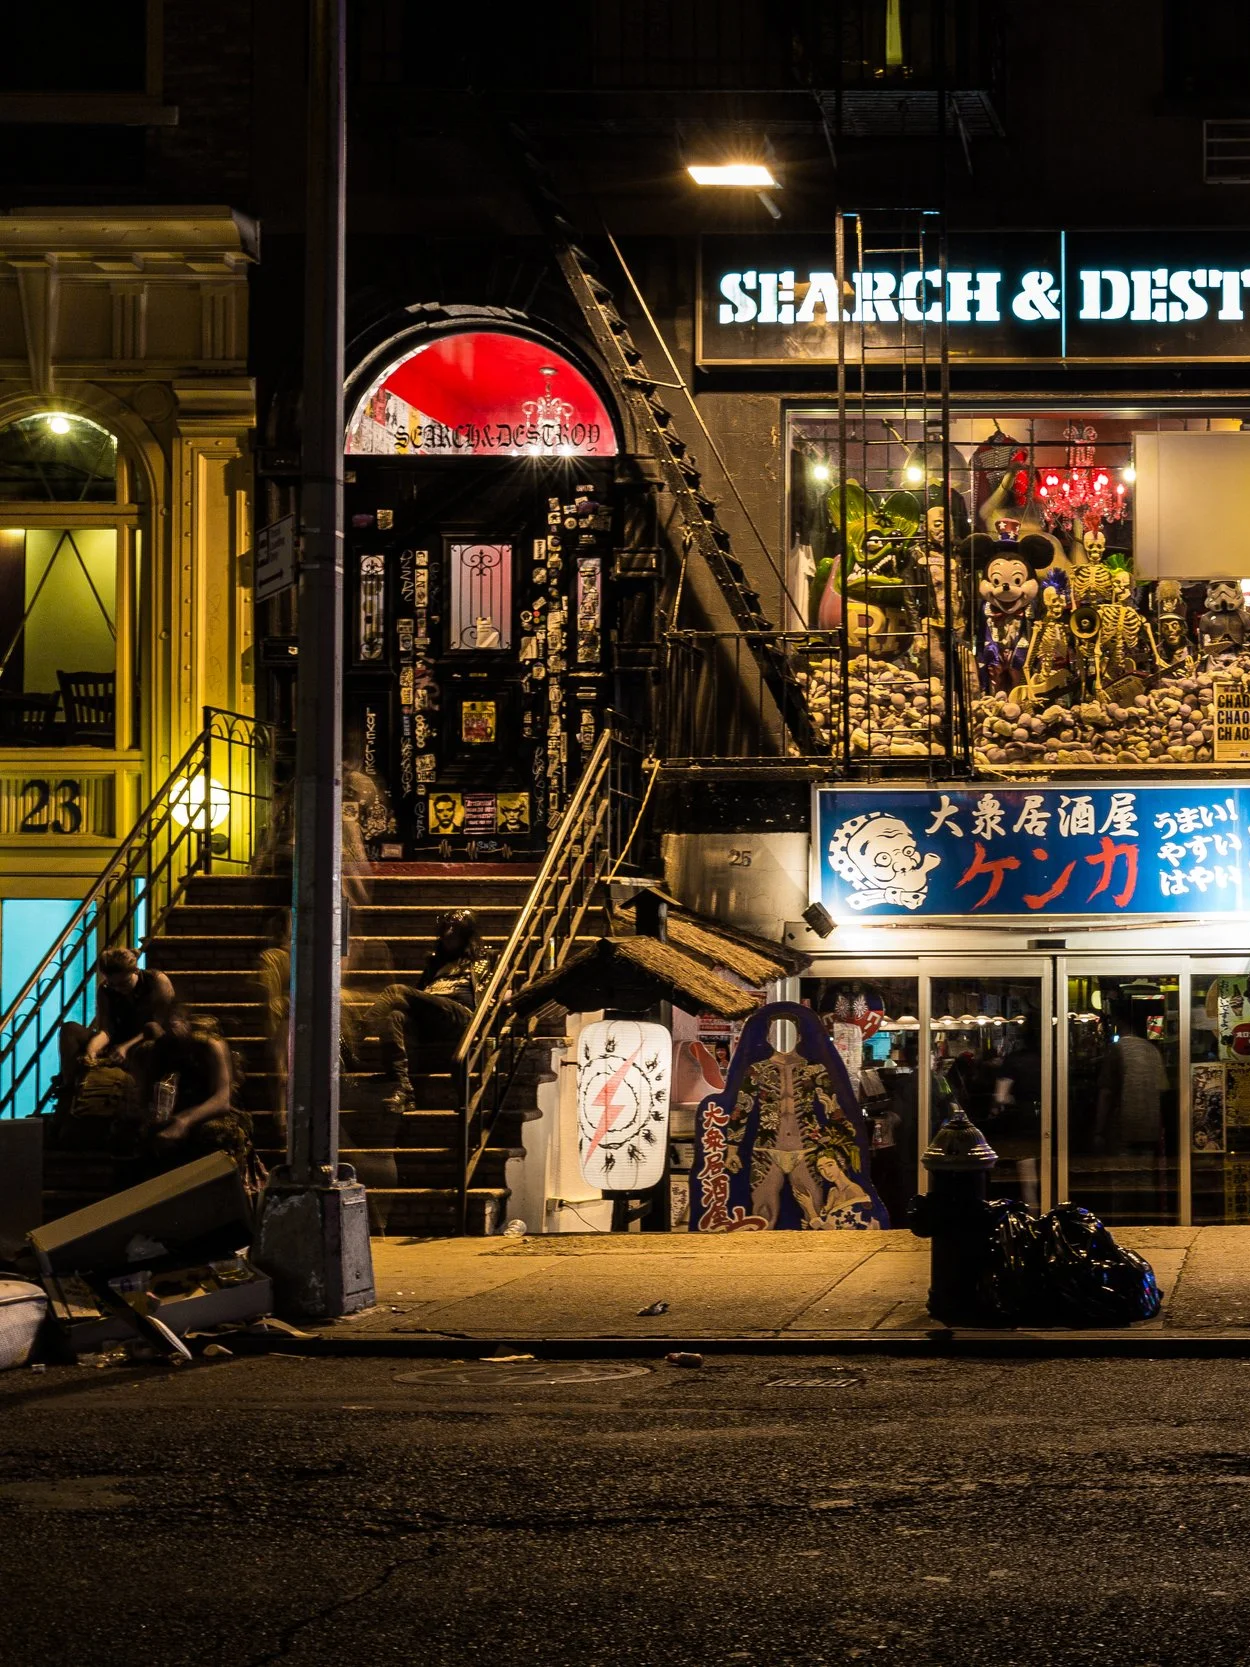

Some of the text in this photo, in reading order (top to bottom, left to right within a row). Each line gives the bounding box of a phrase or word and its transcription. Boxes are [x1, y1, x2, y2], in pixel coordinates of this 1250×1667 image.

[718, 269, 1001, 324] SEARCH
[1012, 269, 1062, 322] &
[20, 779, 82, 834] 23
[925, 793, 1140, 840] 大衆居酒屋
[1153, 799, 1239, 840] うまい！
[727, 849, 753, 867] 25
[954, 836, 1139, 910] ケンカ
